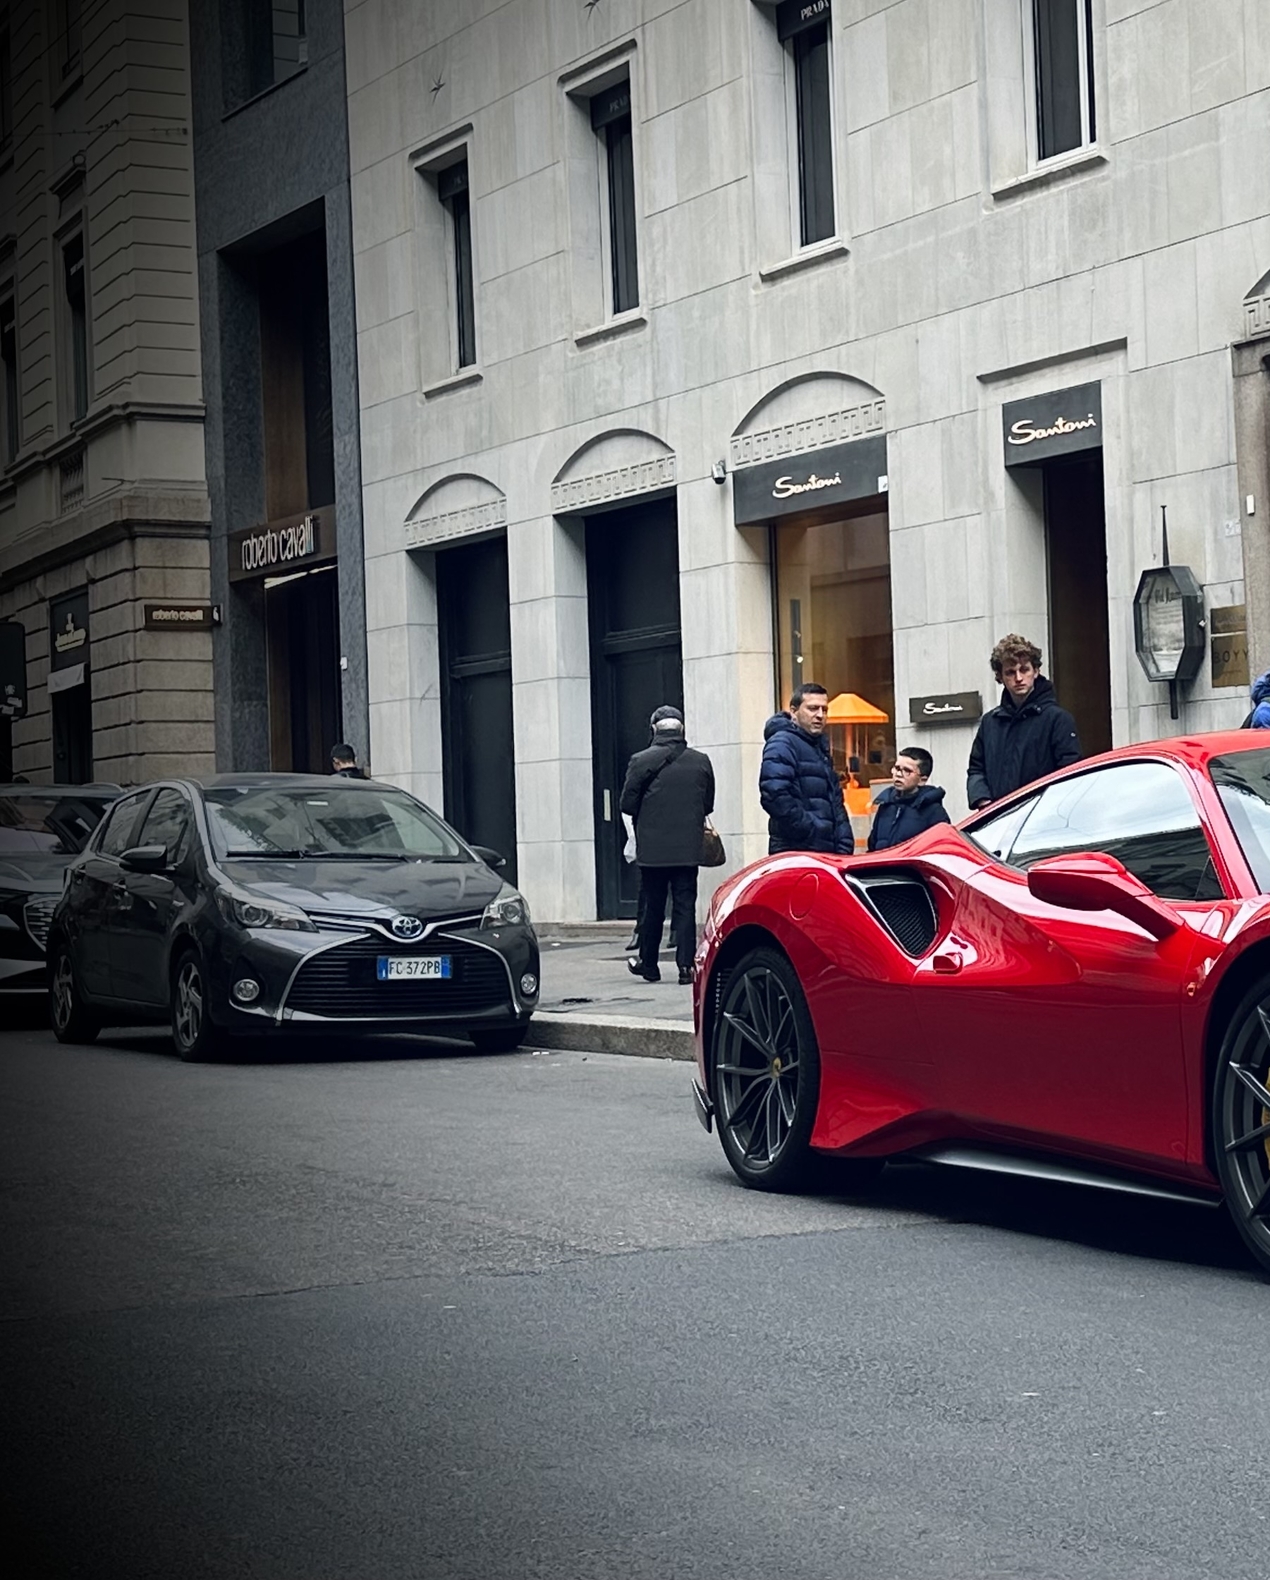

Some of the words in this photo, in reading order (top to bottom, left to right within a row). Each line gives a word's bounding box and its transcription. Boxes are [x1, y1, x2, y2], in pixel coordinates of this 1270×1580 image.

[1008, 413, 1097, 445] Santoni
[772, 472, 842, 499] Santoni
[242, 528, 278, 571] roberto
[279, 514, 315, 562] cavalli
